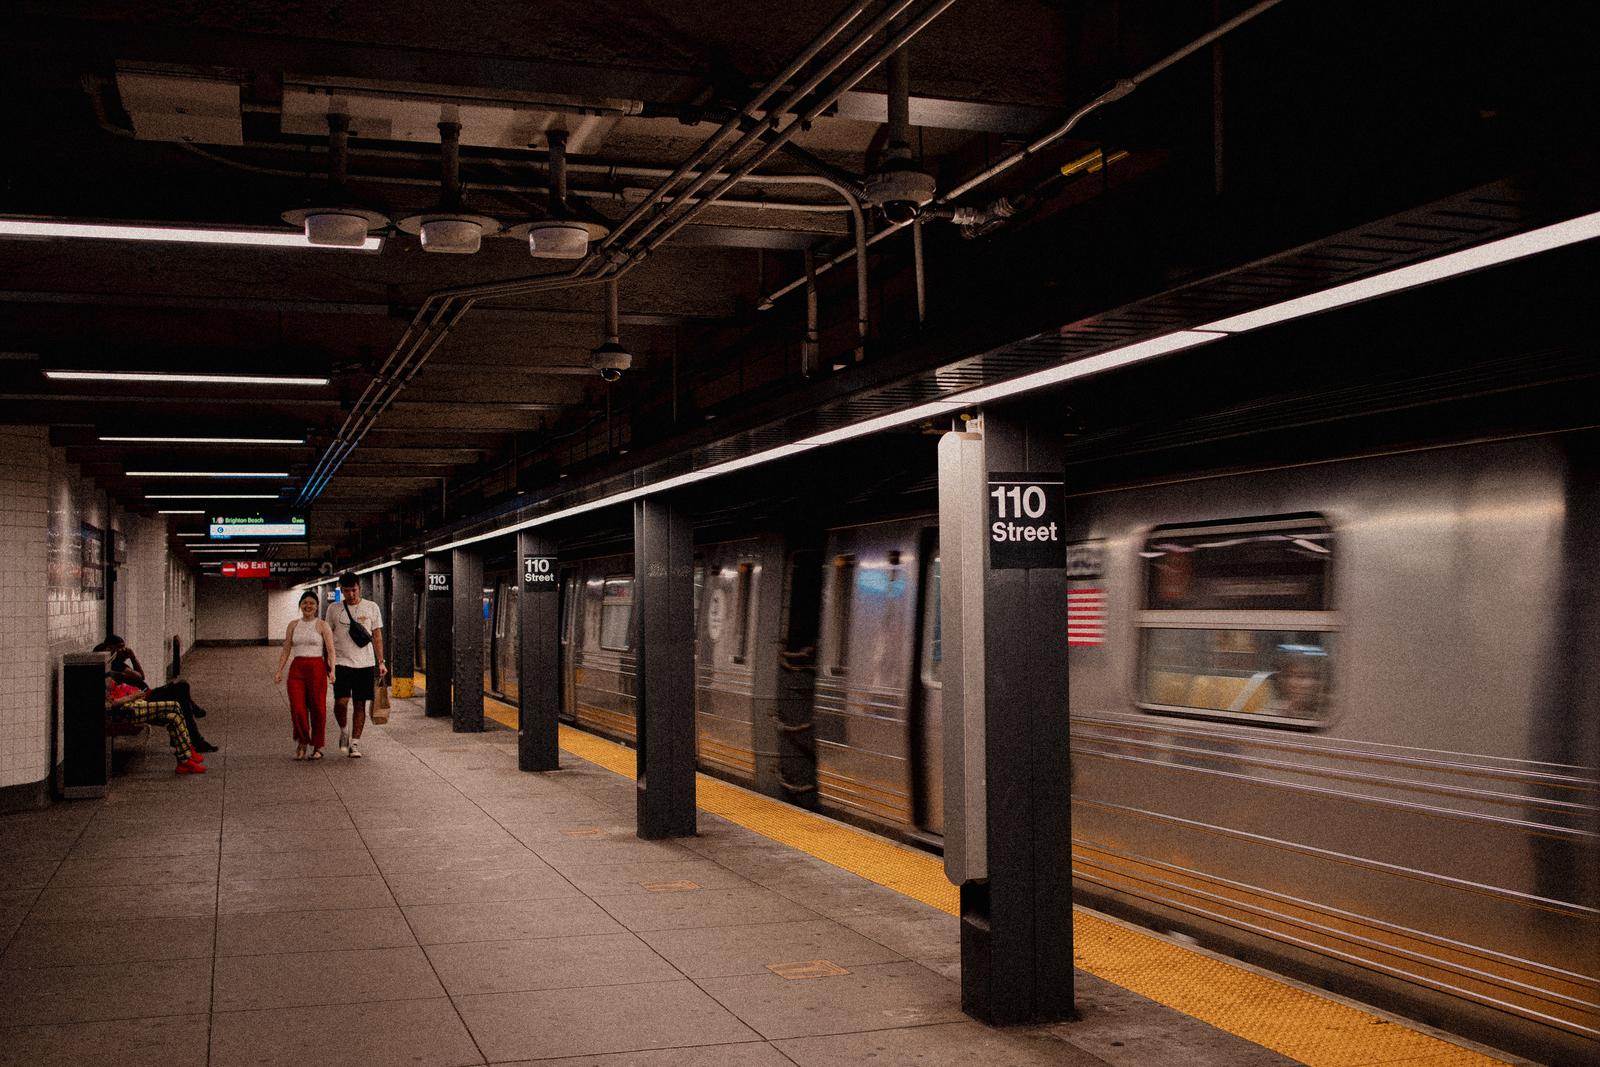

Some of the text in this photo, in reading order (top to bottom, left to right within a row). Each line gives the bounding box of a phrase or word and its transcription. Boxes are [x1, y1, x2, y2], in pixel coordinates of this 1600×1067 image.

[991, 485, 1047, 519] 110
[992, 521, 1058, 542] Street
[237, 561, 267, 569] No Exit
[525, 559, 550, 573] 110
[429, 575, 446, 584] 110
[525, 572, 554, 582] Street
